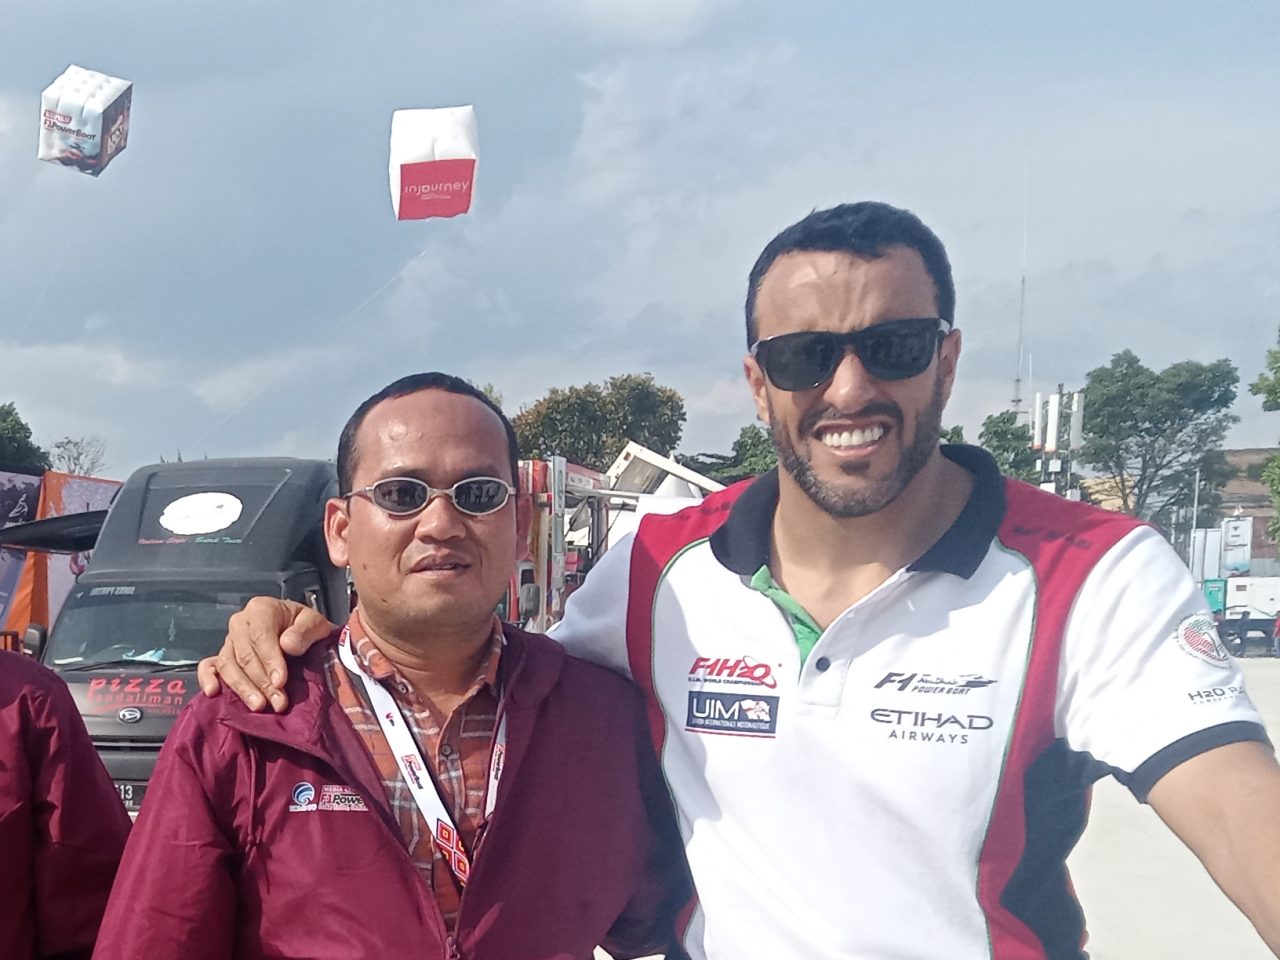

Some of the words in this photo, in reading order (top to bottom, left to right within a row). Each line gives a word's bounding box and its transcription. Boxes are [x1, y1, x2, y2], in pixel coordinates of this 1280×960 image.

[405, 180, 470, 196] injourney
[87, 672, 187, 703] pizza
[693, 698, 740, 720] UIM
[870, 708, 994, 730] ETIHAD
[888, 729, 969, 744] AIRWAYS
[115, 784, 133, 800] 13
